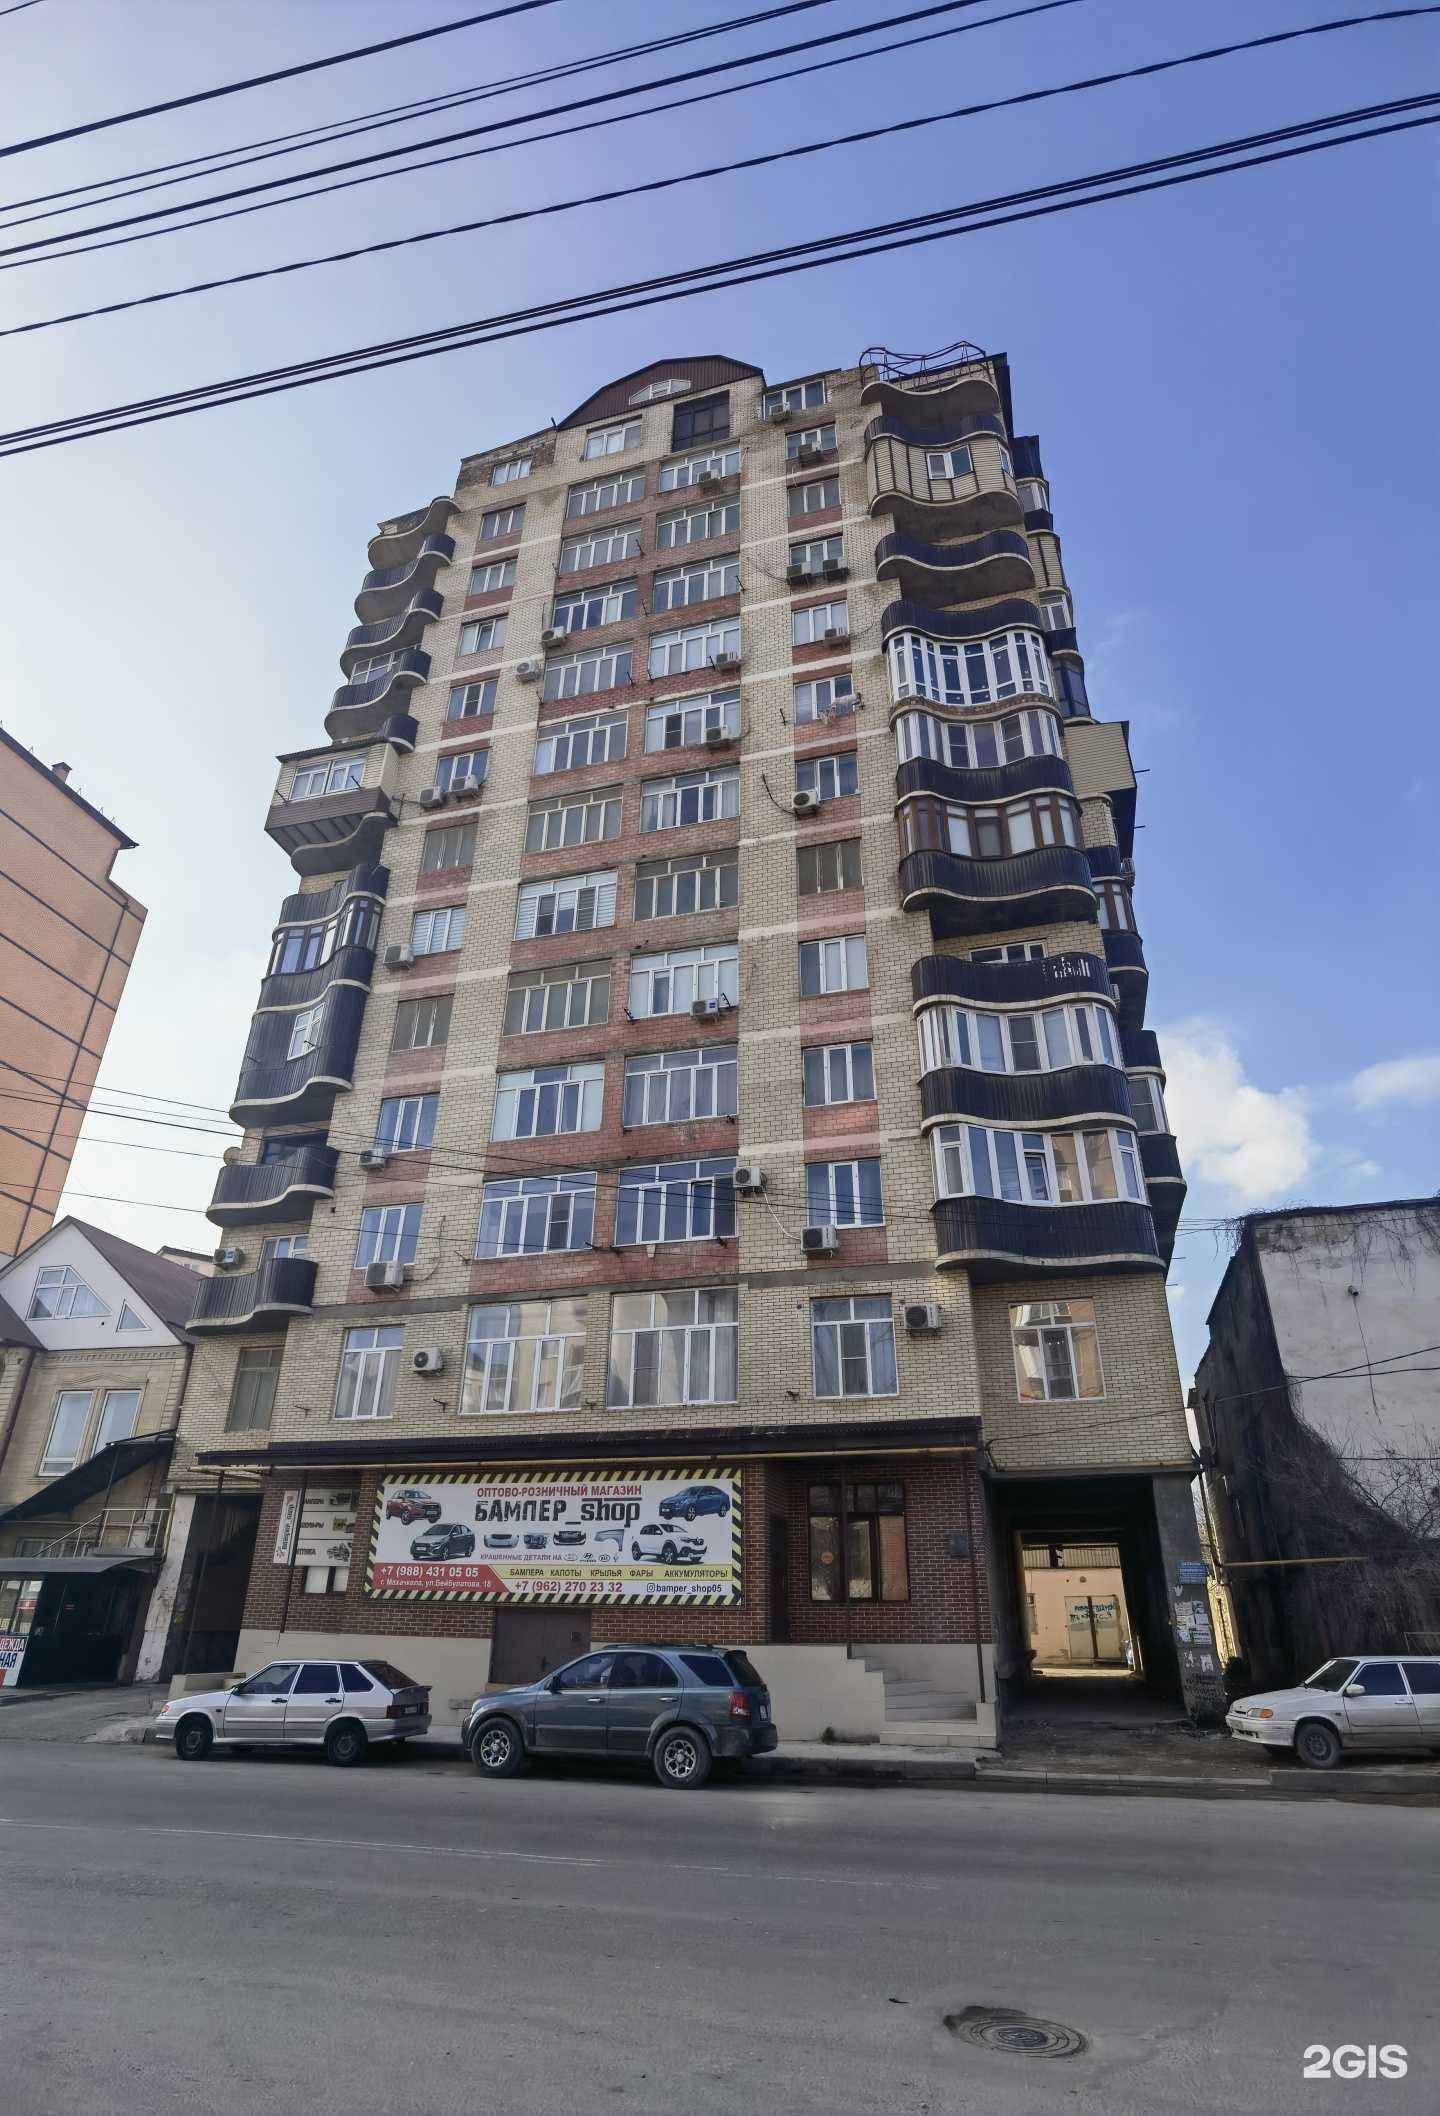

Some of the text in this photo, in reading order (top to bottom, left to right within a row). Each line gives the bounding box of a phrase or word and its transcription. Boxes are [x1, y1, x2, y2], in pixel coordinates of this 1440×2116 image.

[477, 1484, 642, 1498] ОПТОВО-РОЗНИЧНЫЙ МАГАЗИН
[381, 1566, 479, 1577] +7 (988) 431 05 05
[550, 1569, 582, 1577] КАПОТЫ
[664, 1570, 728, 1578] АККУМУЛЯТОРЫ
[515, 1581, 622, 1593] +7 (962) 270 23 32
